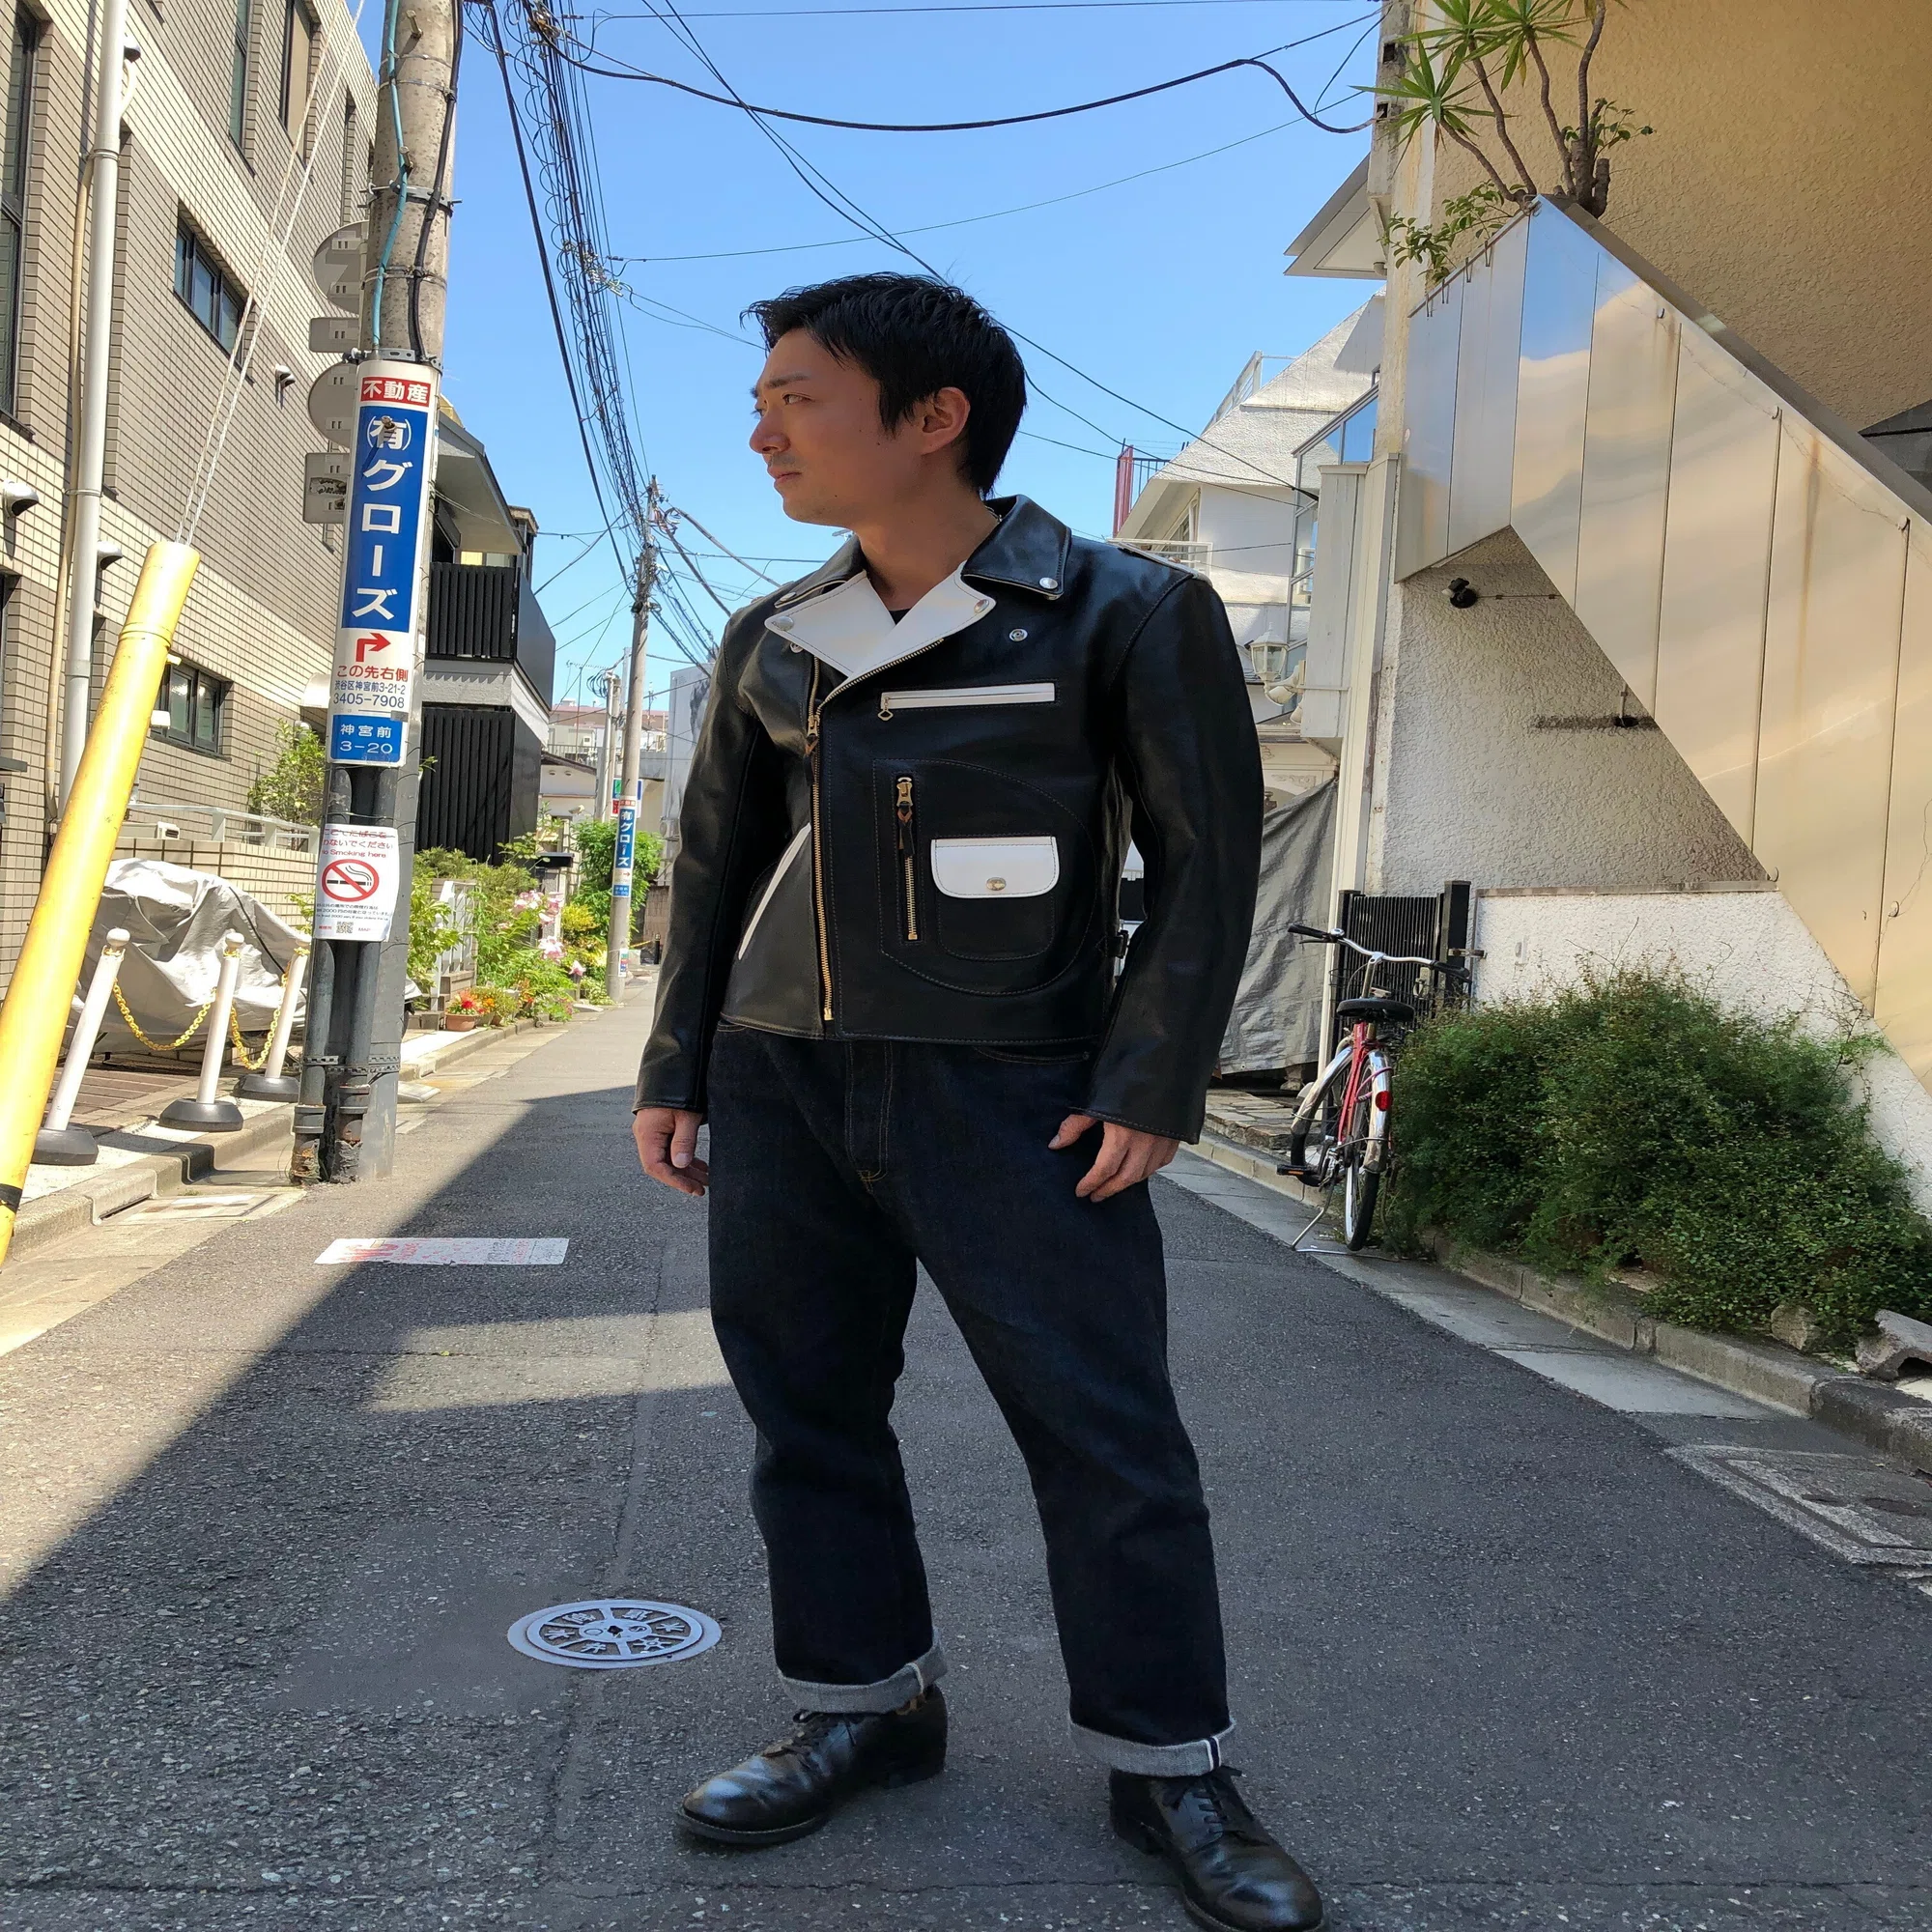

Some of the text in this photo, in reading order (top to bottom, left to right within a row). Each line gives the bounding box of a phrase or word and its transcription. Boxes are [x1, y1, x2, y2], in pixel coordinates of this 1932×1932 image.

[362, 380, 428, 404] 不動産
[337, 665, 409, 682] この先右側
[334, 680, 406, 695] 渋谷区神宮前3-21-2
[333, 693, 405, 708] 3405-7908
[340, 724, 392, 739] 神宮前
[340, 740, 393, 753] 3-20
[330, 848, 365, 858] Smoking
